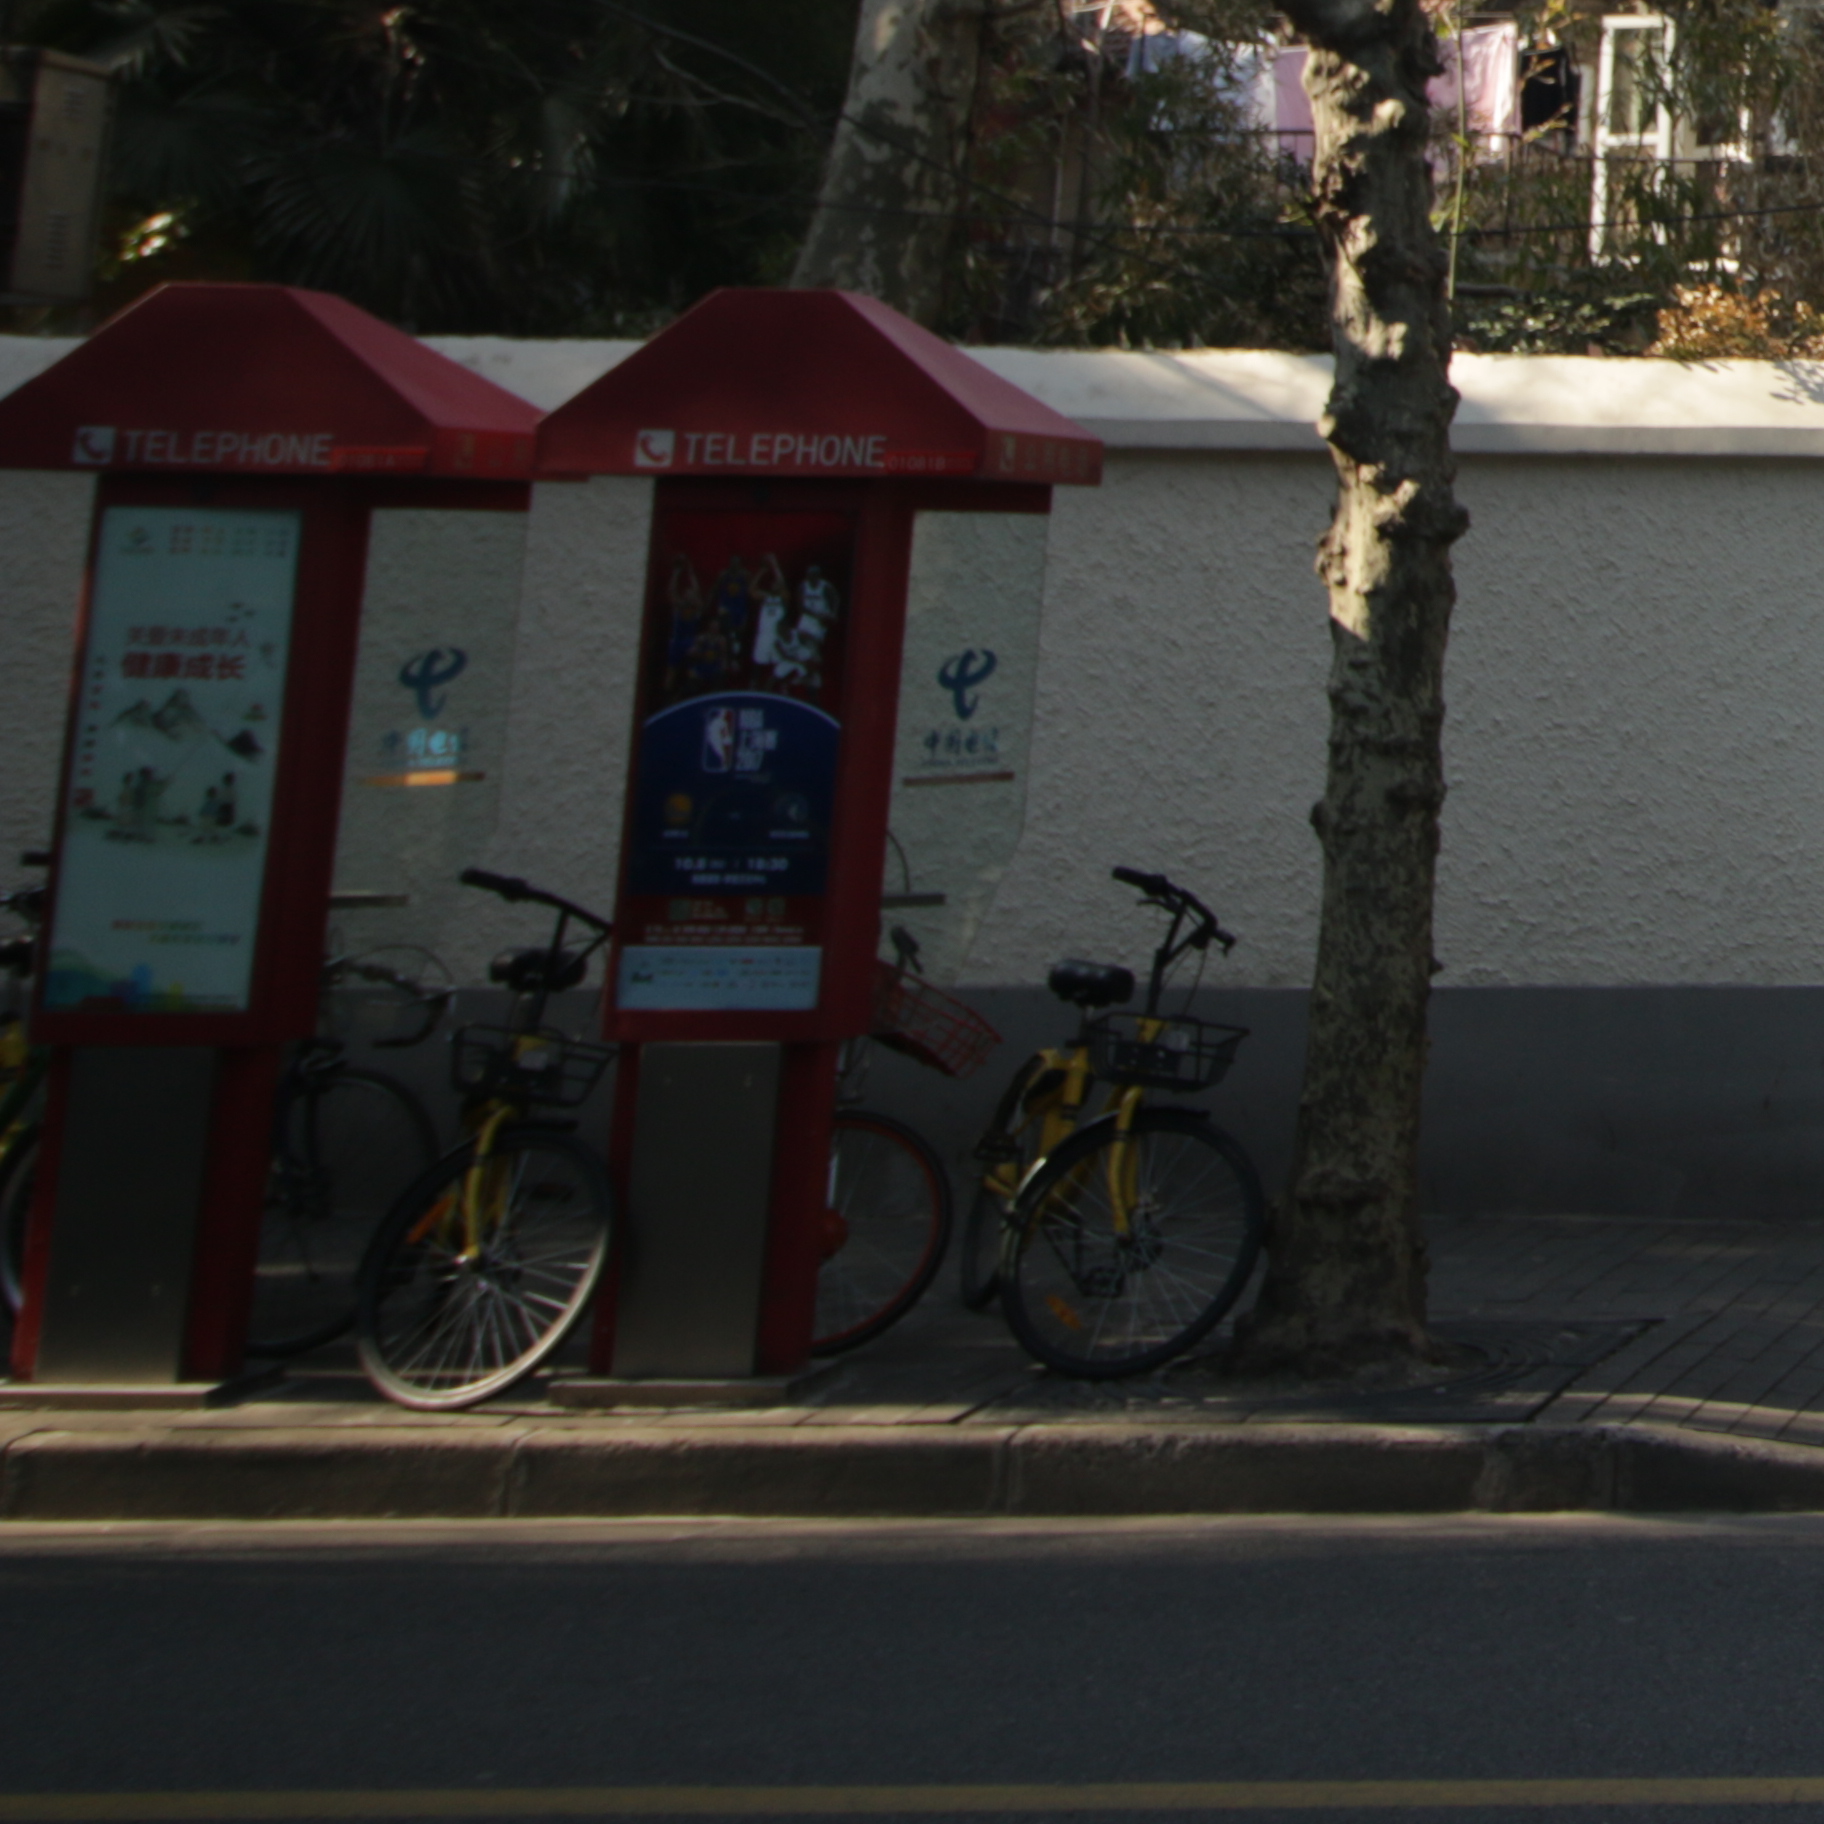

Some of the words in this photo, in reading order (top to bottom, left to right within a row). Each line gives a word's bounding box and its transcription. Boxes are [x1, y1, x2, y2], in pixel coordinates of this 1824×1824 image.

[122, 428, 333, 466] TELEPHONE
[683, 432, 887, 468] TELEPHONE
[122, 651, 246, 679] 健康成长
